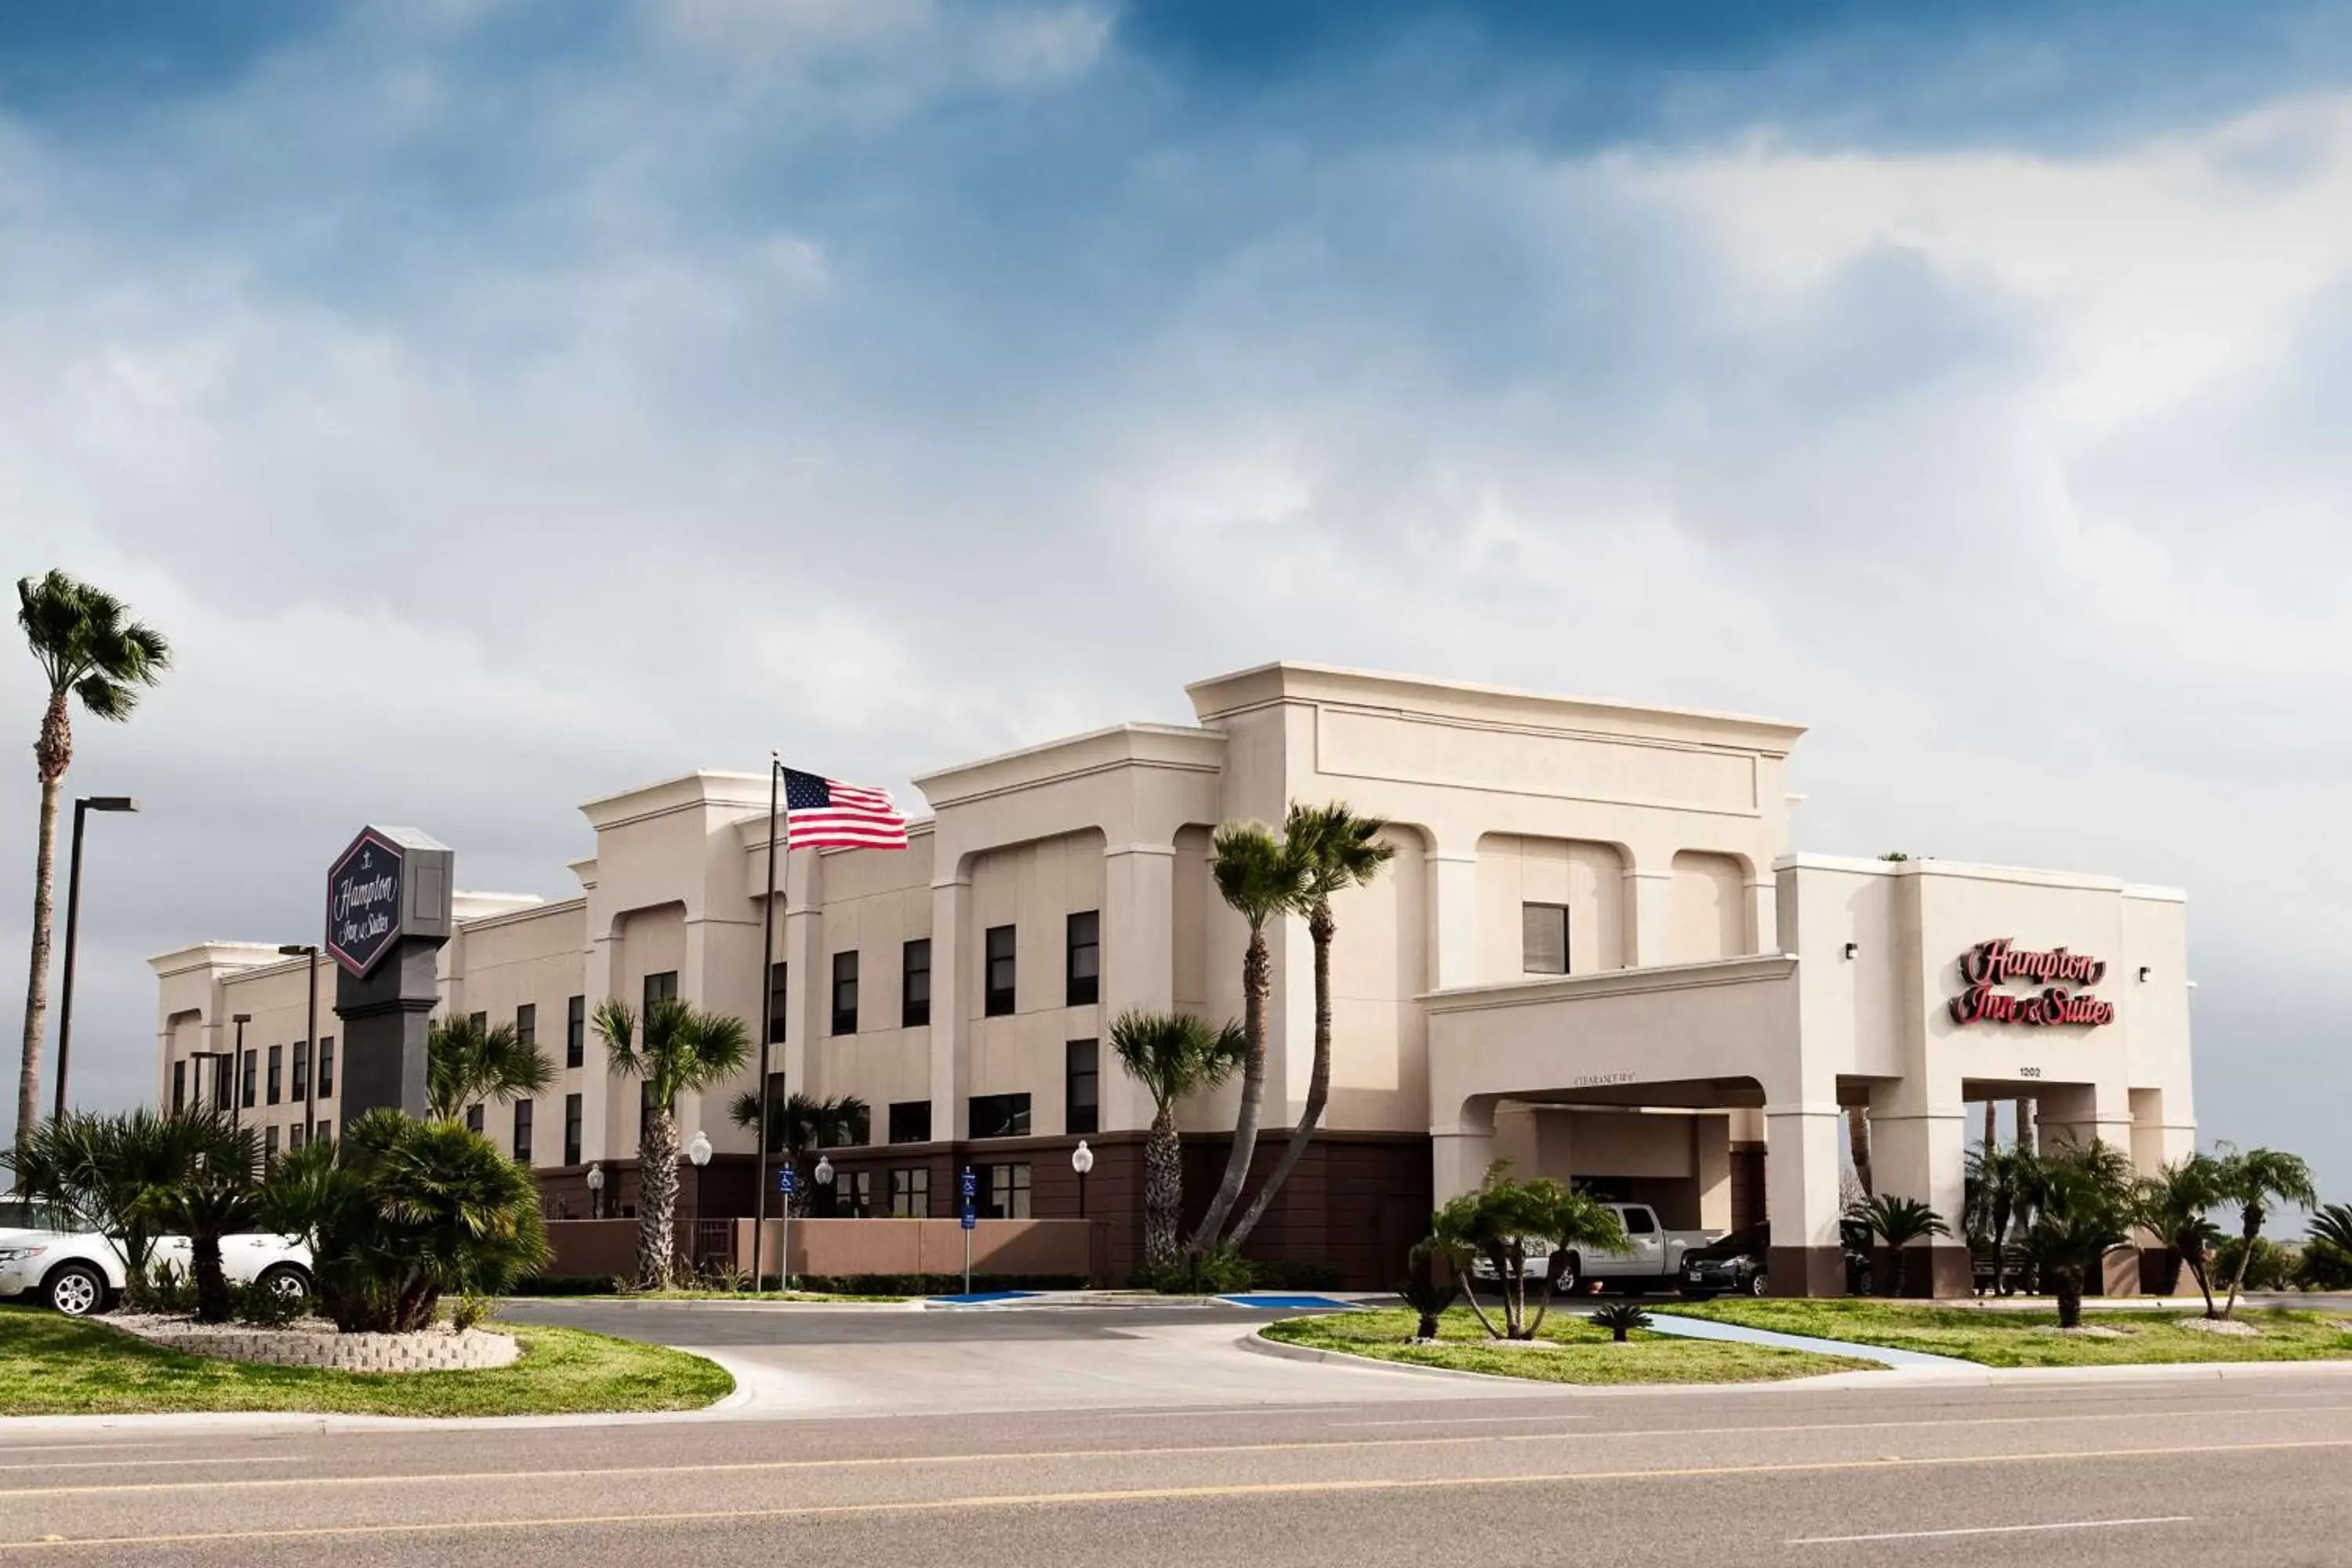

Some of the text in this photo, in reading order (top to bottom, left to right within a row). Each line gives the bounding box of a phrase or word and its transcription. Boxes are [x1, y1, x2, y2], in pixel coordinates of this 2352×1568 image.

[334, 873, 397, 921] Hampton
[1960, 937, 2106, 985] Hampton
[1952, 984, 2027, 1024] Inn
[2042, 986, 2114, 1025] Suites
[2019, 1067, 2041, 1077] 1202
